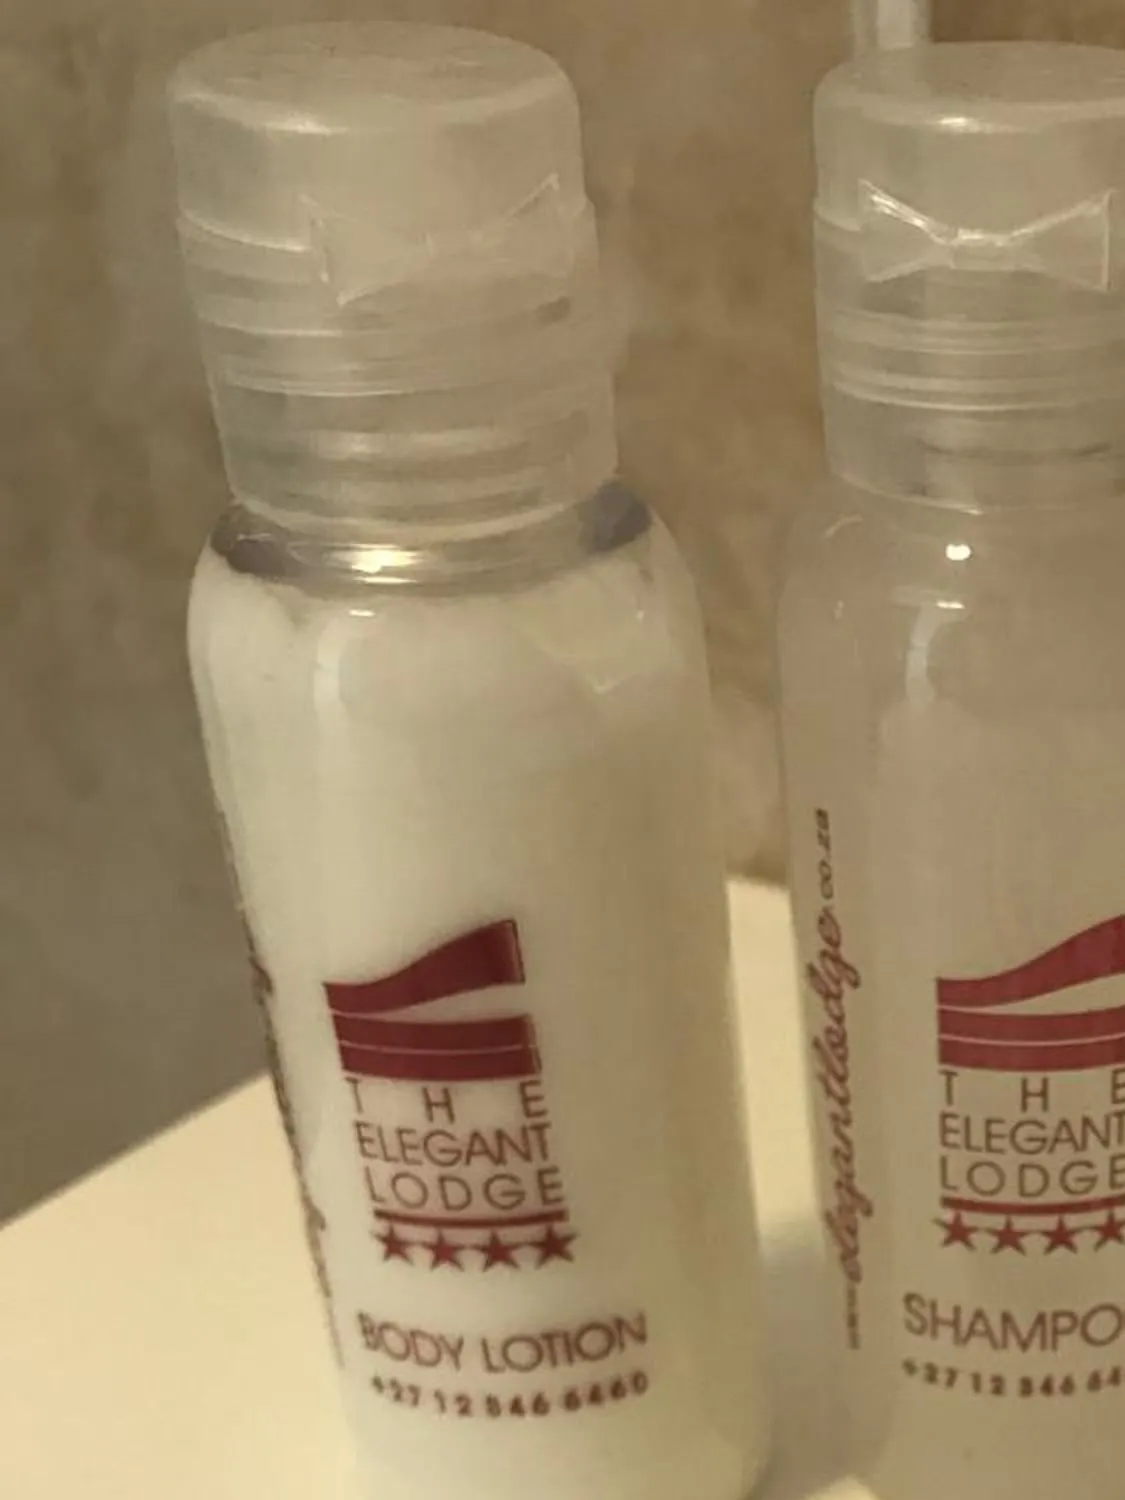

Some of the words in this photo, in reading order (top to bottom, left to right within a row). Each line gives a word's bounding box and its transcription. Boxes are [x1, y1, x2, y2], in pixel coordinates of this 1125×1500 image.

[353, 1120, 552, 1168] ELEGANT
[364, 1166, 567, 1211] LODGE
[357, 1310, 466, 1371] BODY
[480, 1311, 648, 1374] LOTION
[902, 1358, 960, 1389] +27
[971, 1370, 1006, 1397] 12
[433, 1390, 473, 1417] 12
